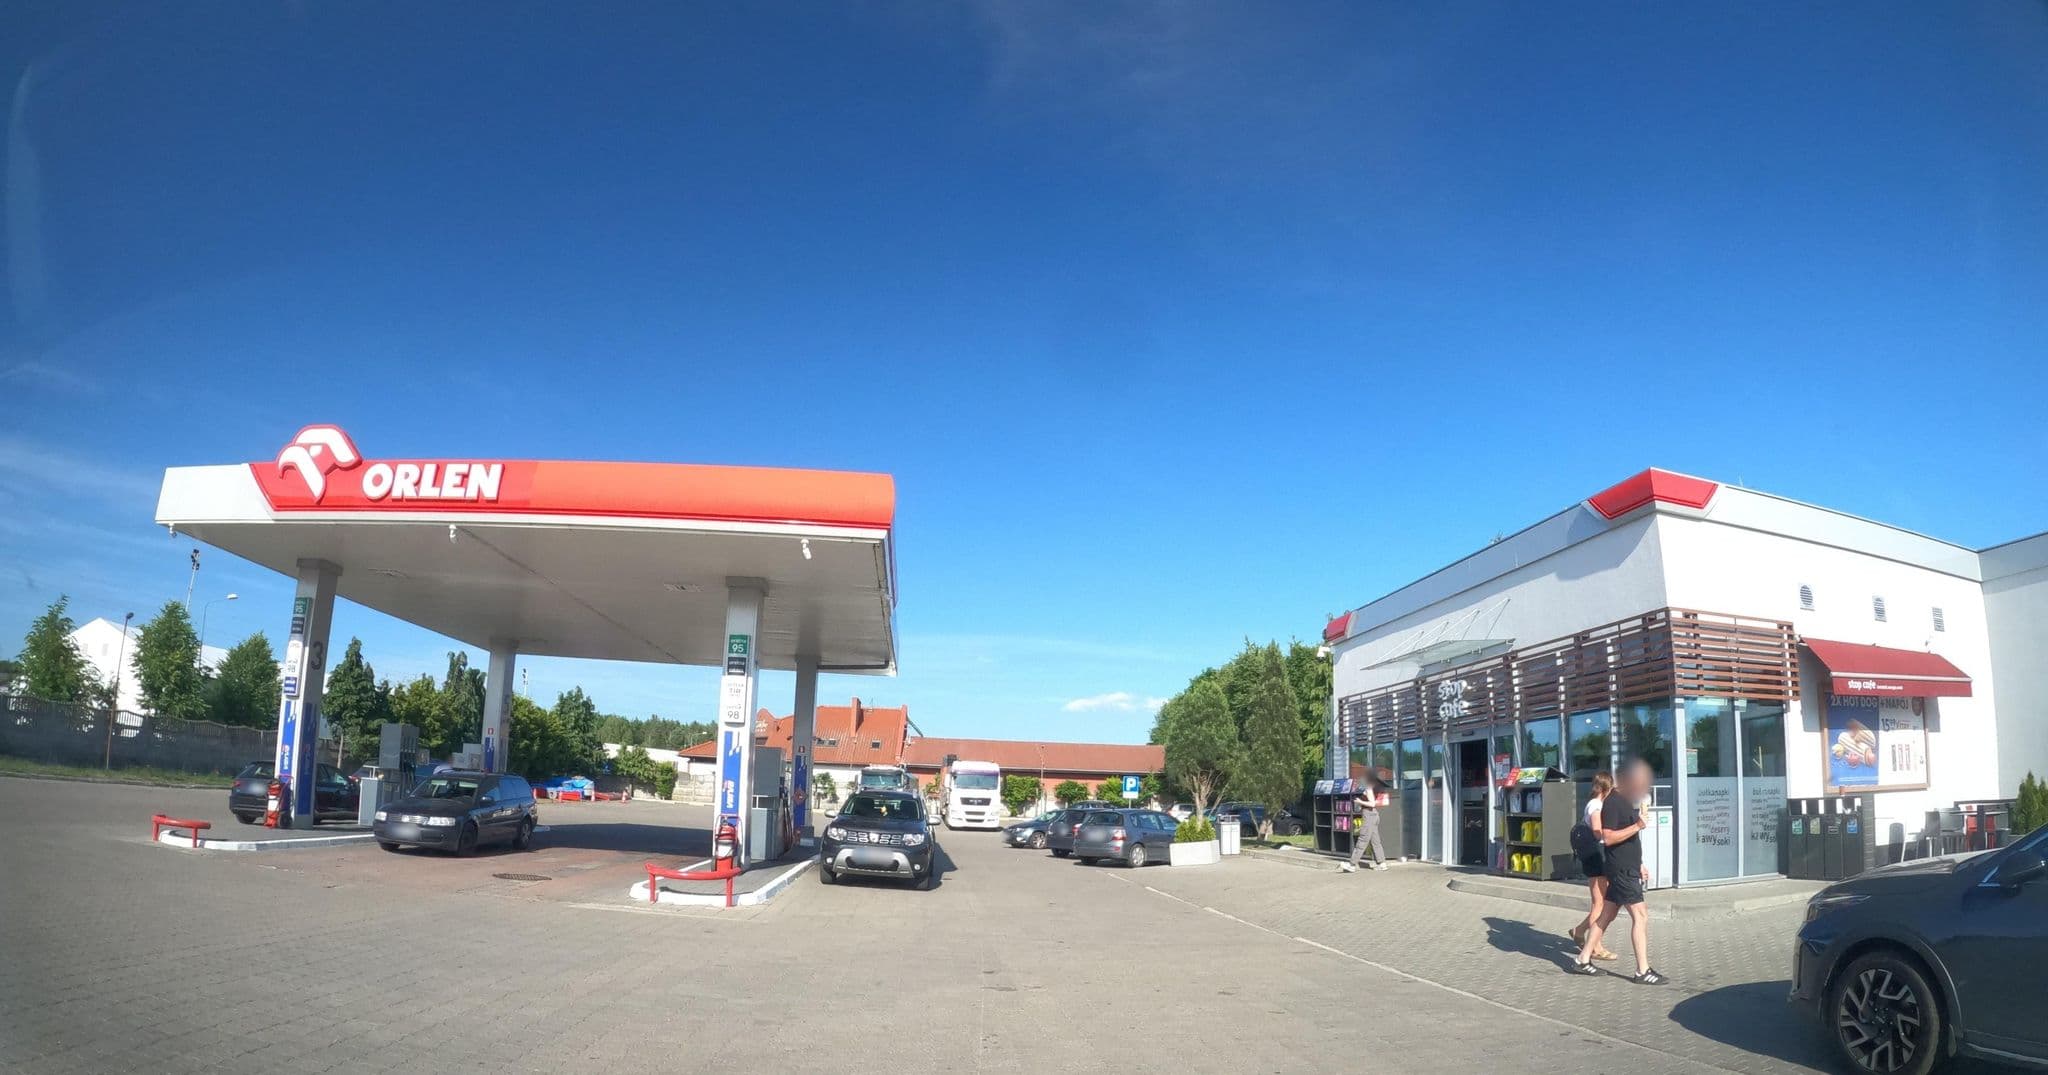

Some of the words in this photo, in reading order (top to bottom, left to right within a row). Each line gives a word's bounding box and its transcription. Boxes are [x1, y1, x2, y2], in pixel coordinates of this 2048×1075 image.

[361, 462, 504, 502] ORLEN
[731, 643, 744, 652] 95
[311, 640, 323, 670] 3
[1438, 679, 1468, 700] stop
[1848, 679, 1862, 691] stop
[1862, 680, 1876, 691] cafe
[1843, 696, 1859, 708] HOT
[1860, 697, 1878, 709] DOG
[727, 710, 740, 719] 98
[1126, 777, 1136, 791] P
